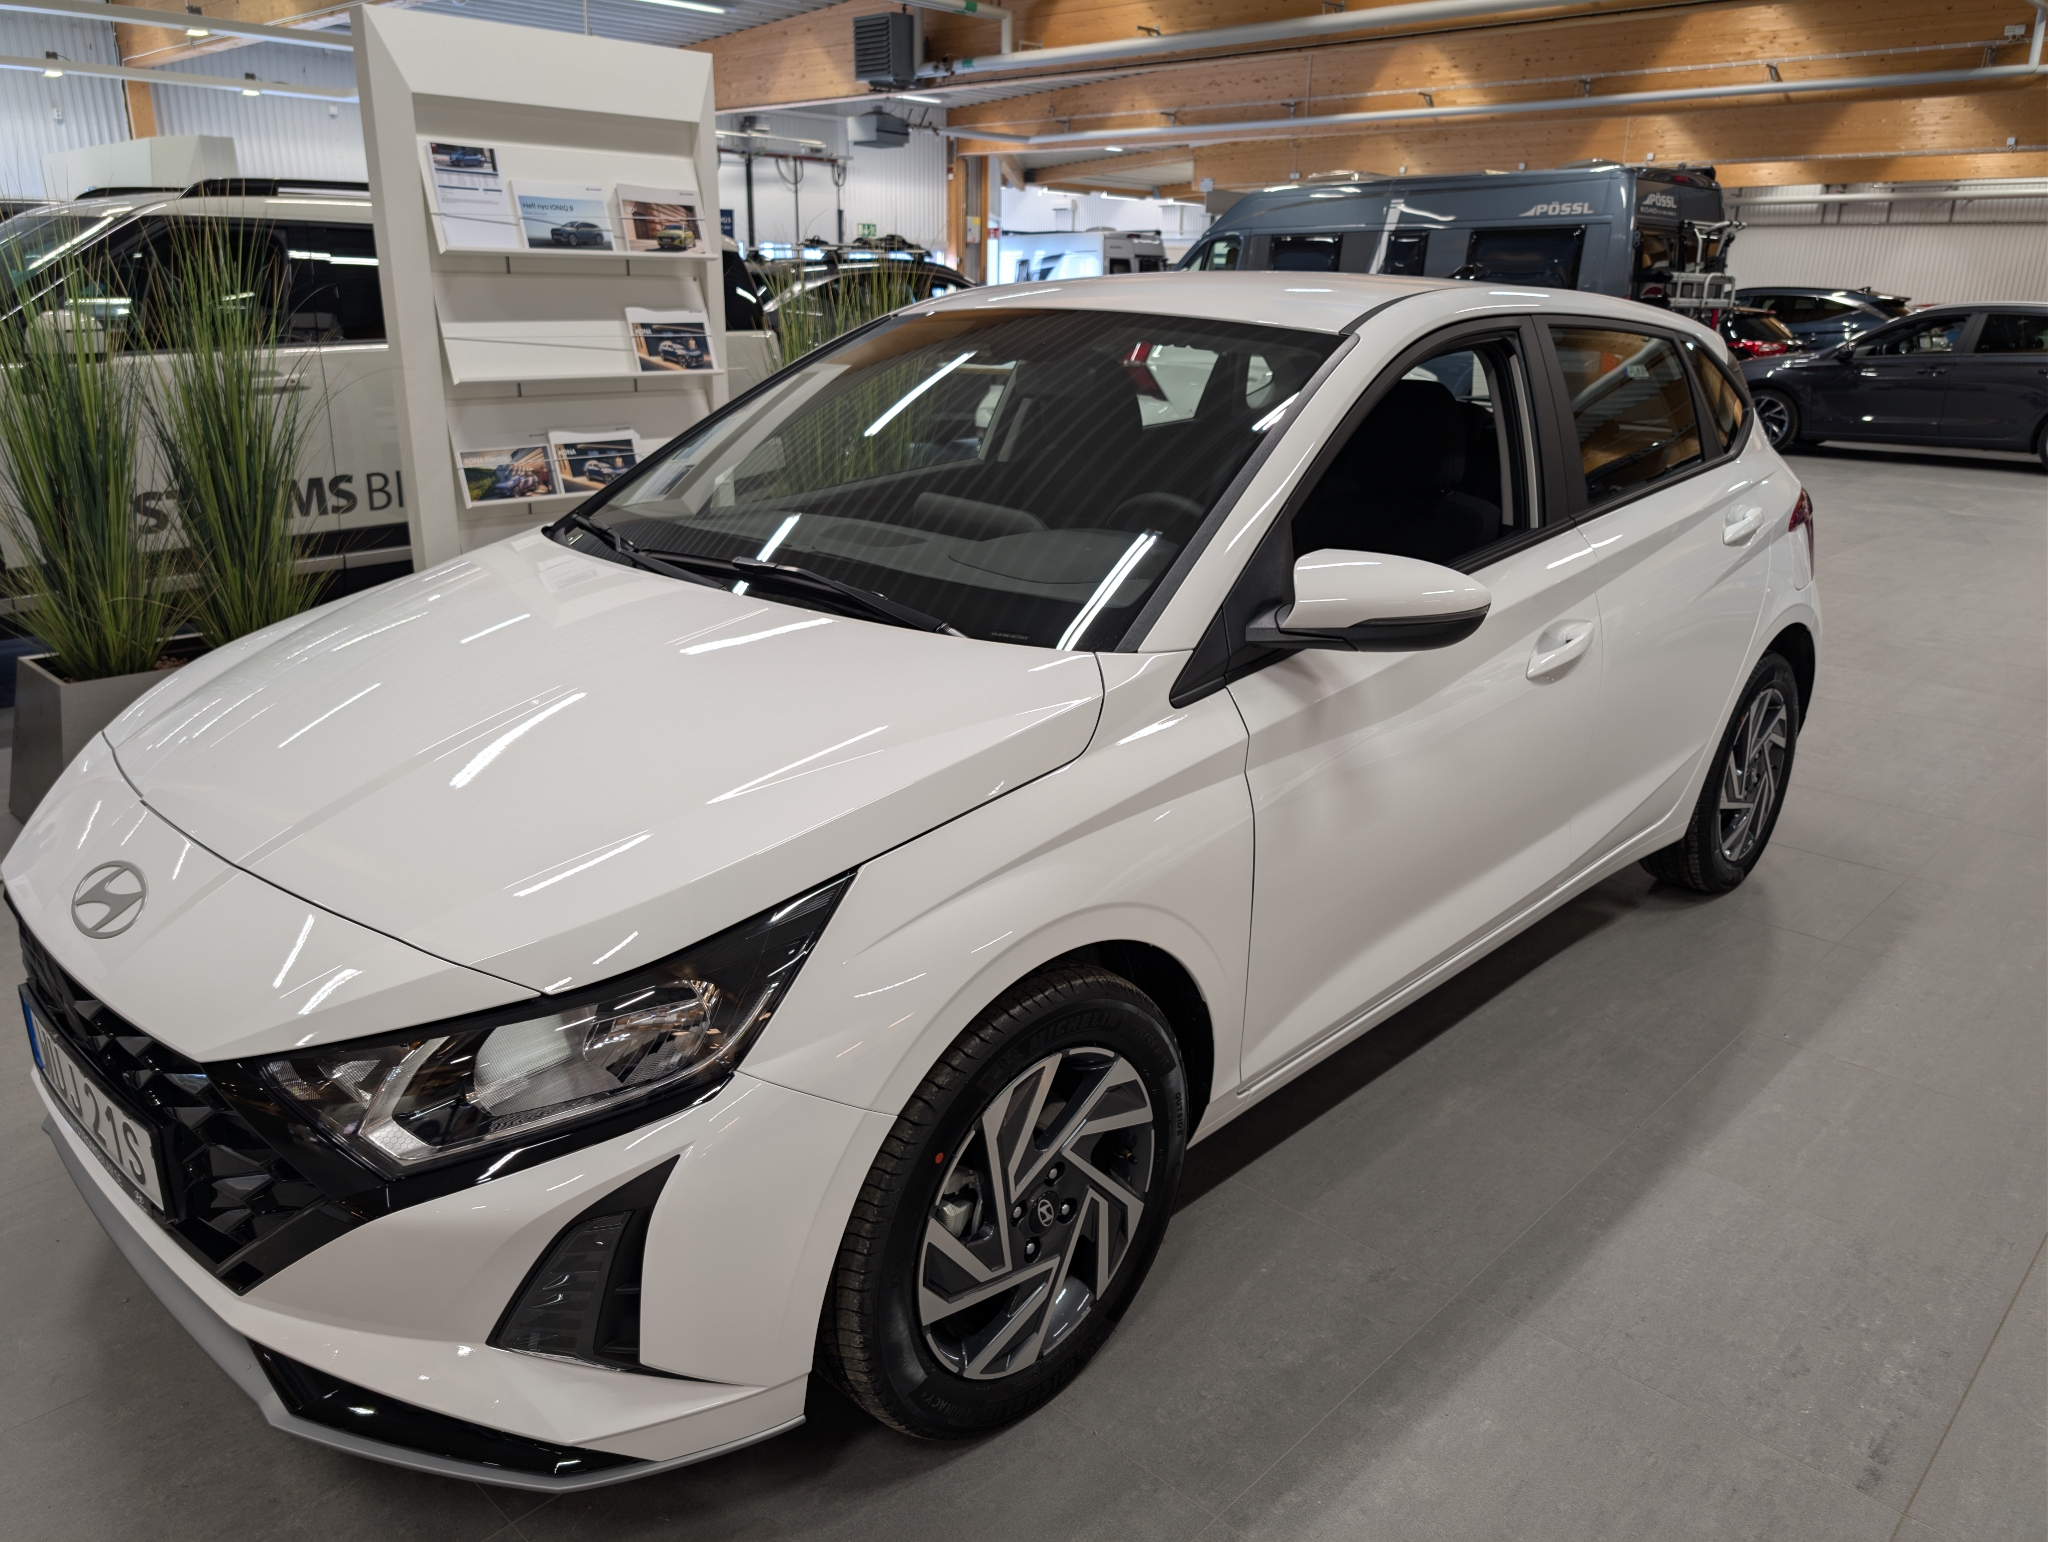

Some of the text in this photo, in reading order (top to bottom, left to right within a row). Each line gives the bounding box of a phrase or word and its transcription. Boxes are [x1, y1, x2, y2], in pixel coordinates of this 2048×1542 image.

[1536, 201, 1595, 216] PÖSSL
[1650, 192, 1677, 209] PÖSSL
[464, 456, 484, 465] KONA
[557, 448, 577, 456] KONA
[1029, 1011, 1122, 1054] MICHELIN
[1175, 1091, 1184, 1136] OUTSIDE
[84, 1082, 146, 1185] 21S
[924, 1393, 972, 1419] PRIMACY
